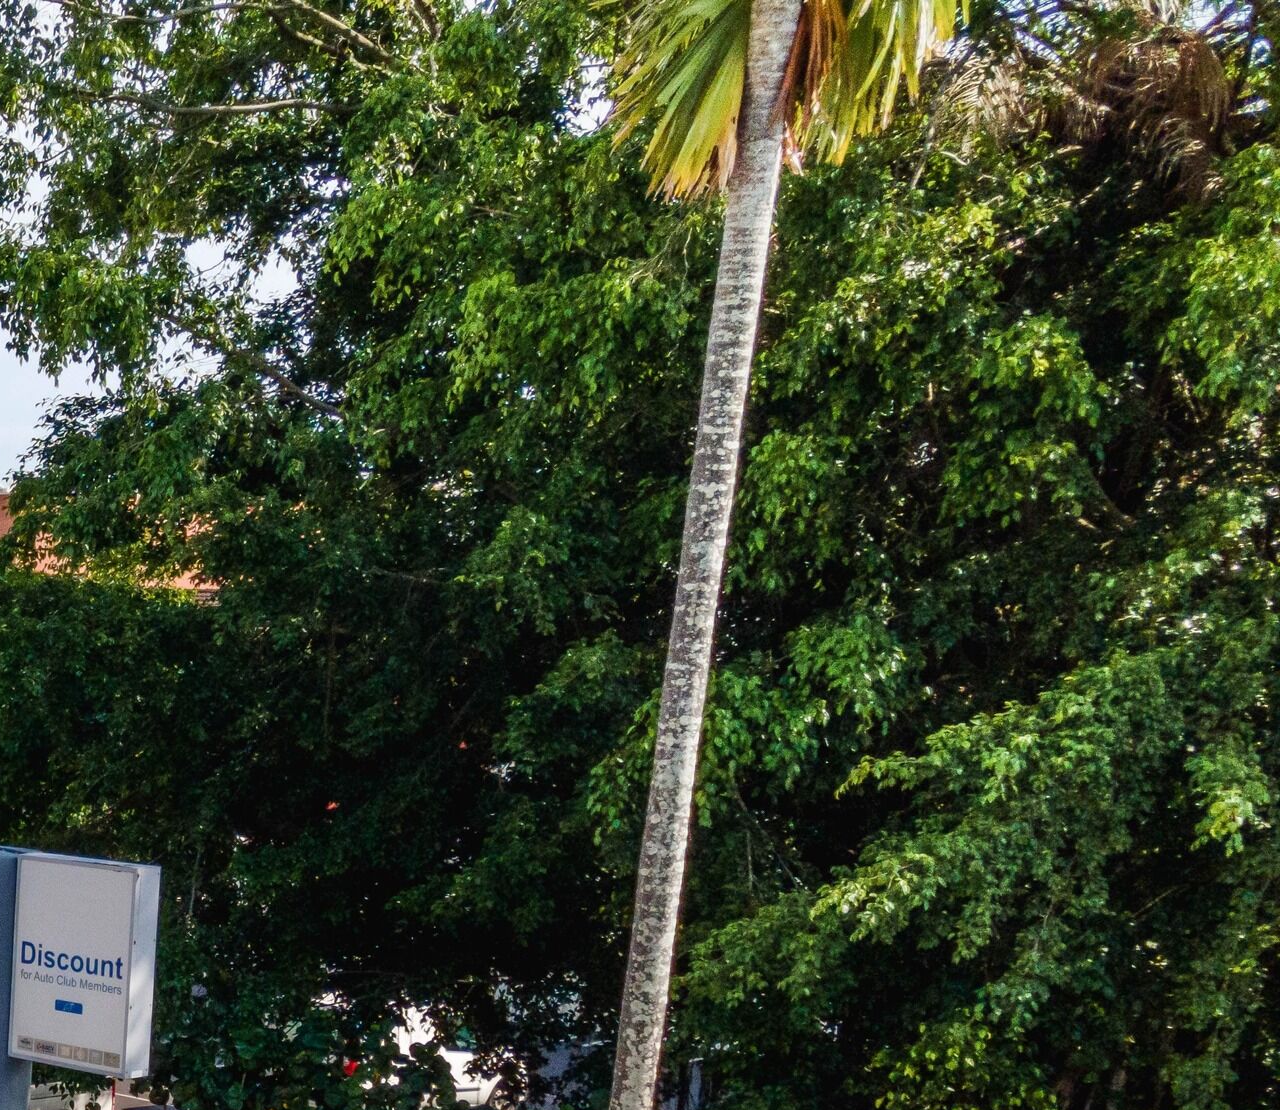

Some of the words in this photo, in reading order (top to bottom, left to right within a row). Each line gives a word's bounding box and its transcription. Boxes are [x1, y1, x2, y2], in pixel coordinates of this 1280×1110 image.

[21, 941, 123, 980] Discount
[20, 968, 32, 980] for
[33, 971, 54, 984] Auto
[56, 975, 77, 988] Club
[79, 979, 122, 995] Members
